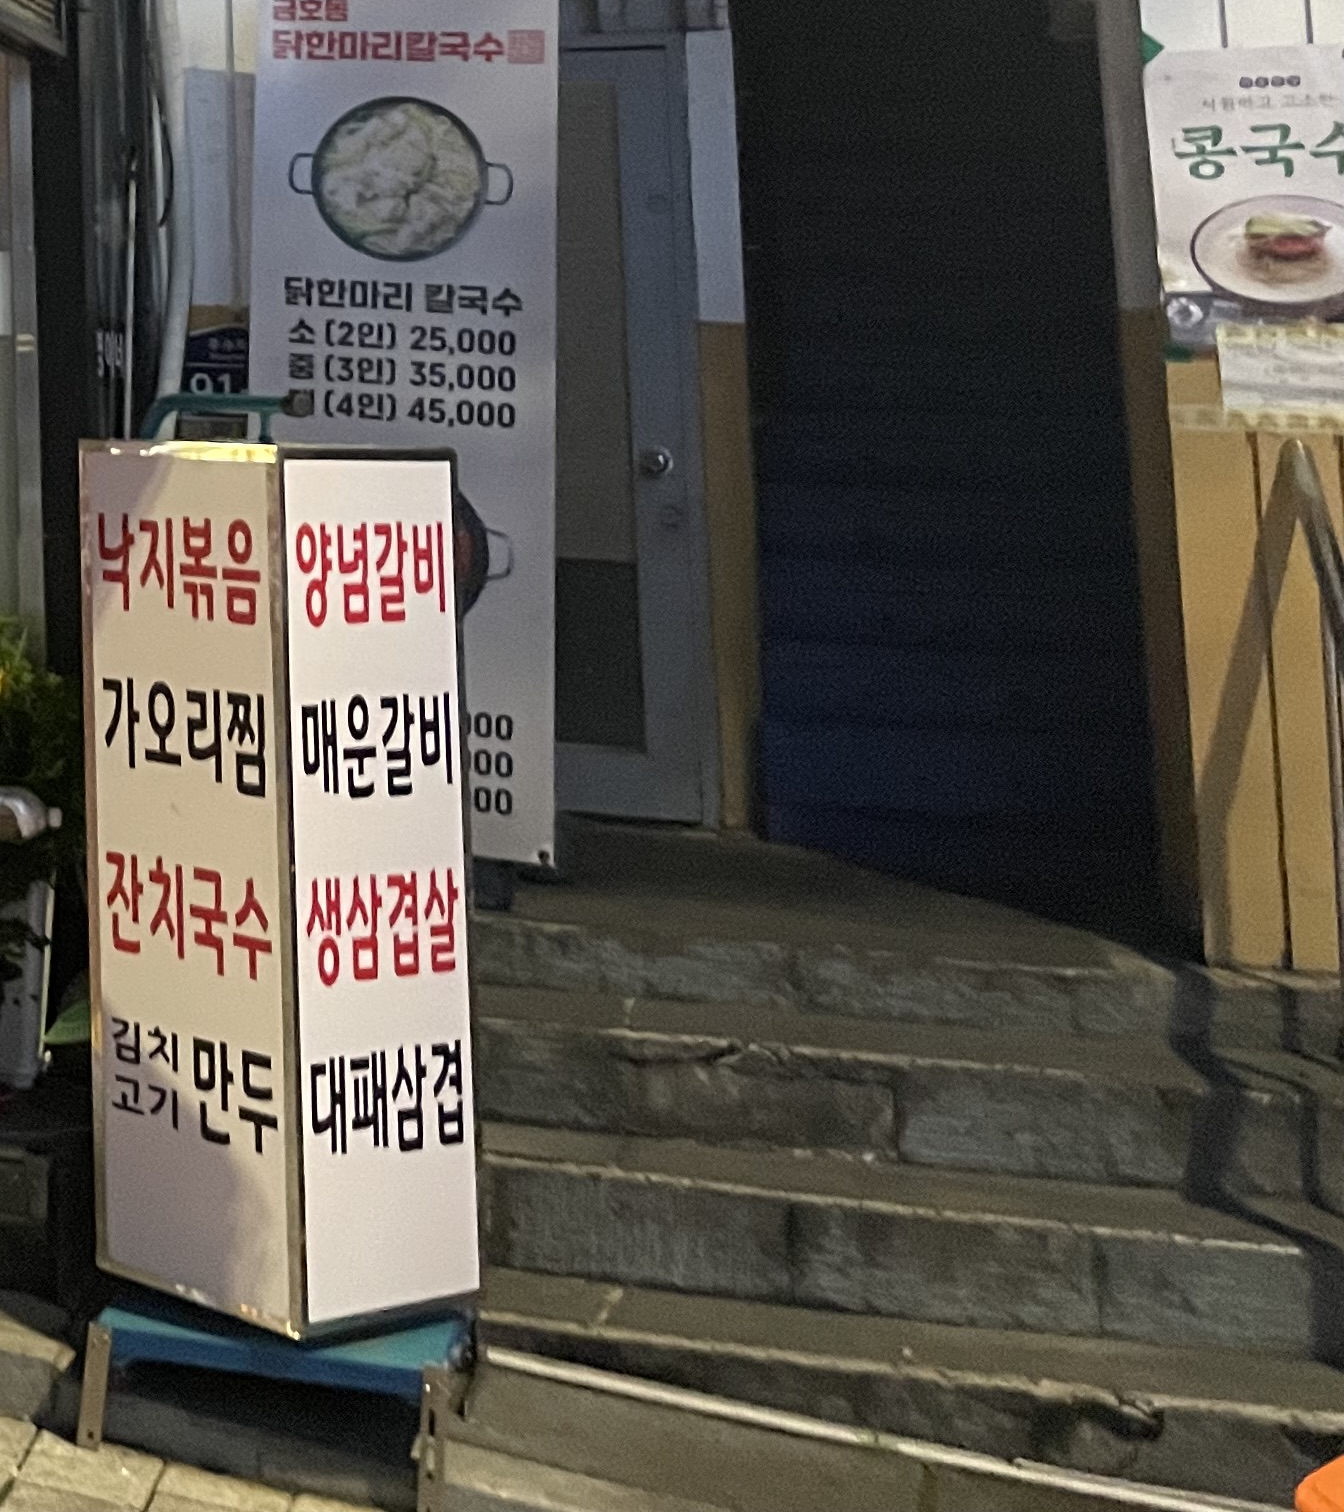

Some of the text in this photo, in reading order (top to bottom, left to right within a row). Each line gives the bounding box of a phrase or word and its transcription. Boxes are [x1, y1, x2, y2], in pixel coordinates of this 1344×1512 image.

[284, 275, 523, 318] 닭한마리 칼국수
[289, 317, 516, 357] 소 (2인) 25,000
[324, 355, 397, 386] (3인)
[409, 362, 516, 393] 35,000
[324, 391, 397, 423] (4인)
[407, 399, 516, 429] 45,000
[97, 513, 262, 627] 낙지볶음
[295, 520, 448, 627] 양념갈비
[102, 676, 267, 799] 가오리찜
[300, 691, 454, 800] 매운갈비
[106, 850, 273, 982] 잔치국수
[306, 867, 459, 988] 생삼겹살
[112, 1018, 180, 1074] 김치
[193, 1038, 278, 1154] 만두
[310, 1039, 465, 1156] 대패삼겹
[112, 1074, 180, 1131] 고기
